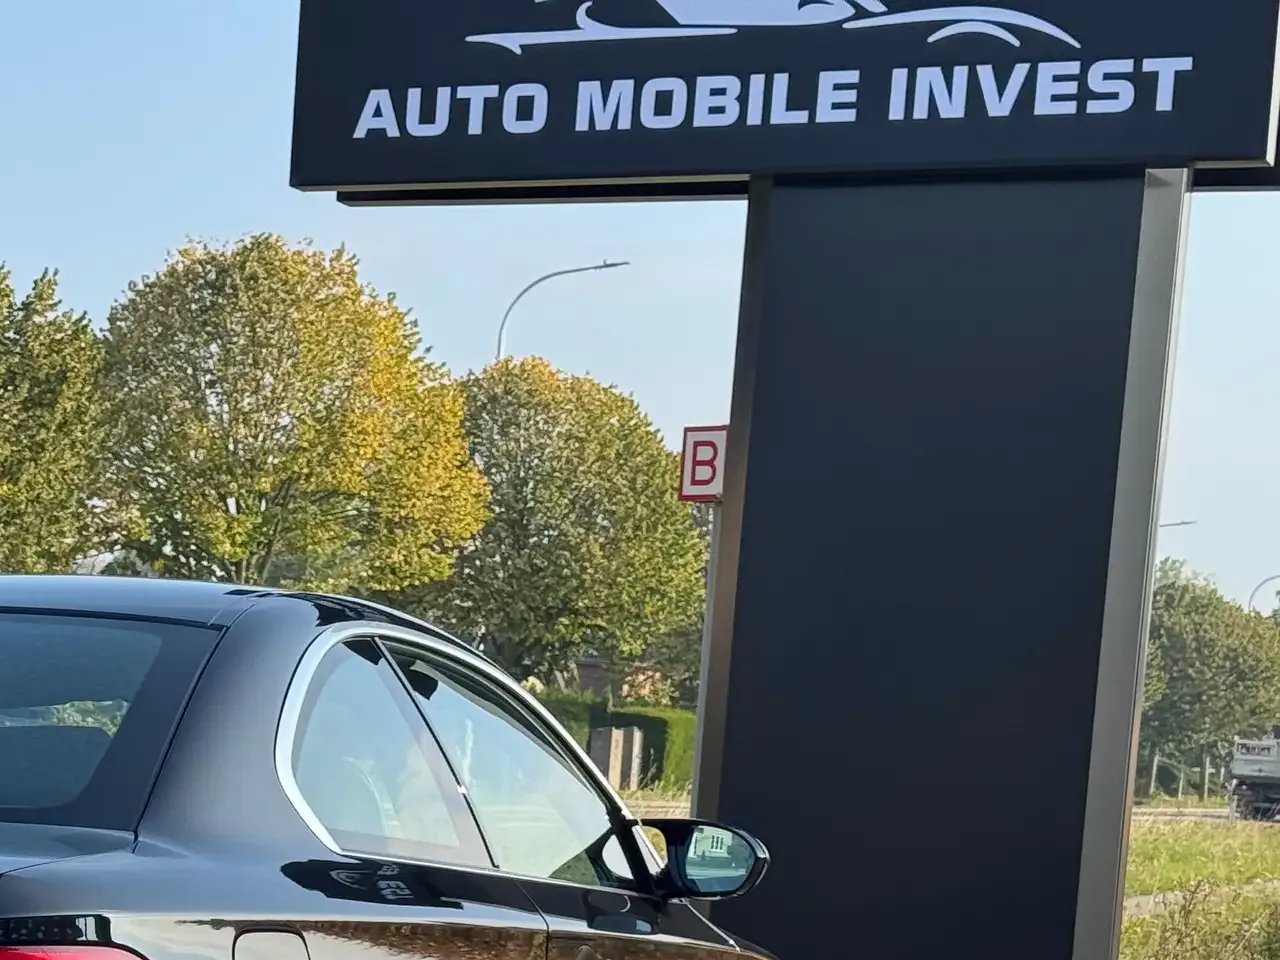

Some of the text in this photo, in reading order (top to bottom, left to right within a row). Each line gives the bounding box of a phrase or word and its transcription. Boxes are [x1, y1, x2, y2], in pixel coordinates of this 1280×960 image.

[352, 56, 1194, 139] AUTO MOBILE INVEST
[690, 440, 719, 486] B
